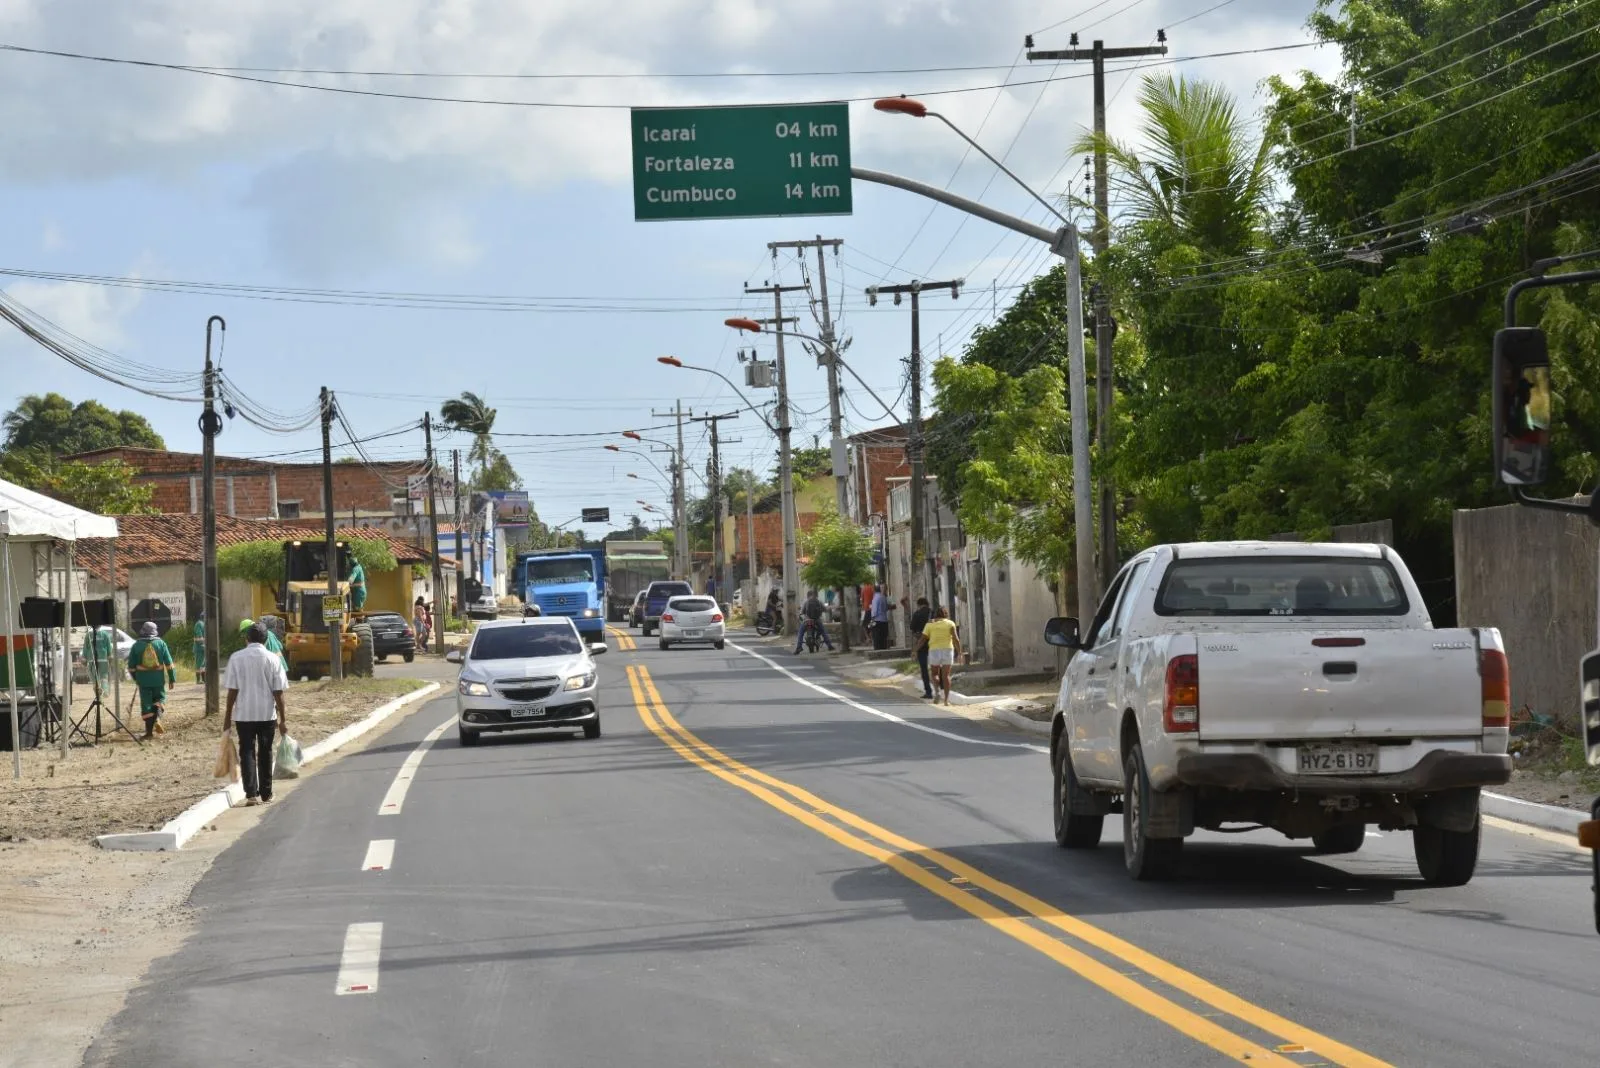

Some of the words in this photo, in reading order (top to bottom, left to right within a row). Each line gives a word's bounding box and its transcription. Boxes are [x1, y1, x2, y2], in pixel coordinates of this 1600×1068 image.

[643, 124, 696, 142] Icaraí
[775, 121, 801, 138] 04
[809, 121, 838, 137] km
[645, 155, 735, 172] Fortaleza
[789, 152, 802, 168] 11
[810, 152, 839, 167] km
[646, 186, 737, 203] Cumbuco
[784, 183, 803, 199] 14
[811, 182, 840, 198] km
